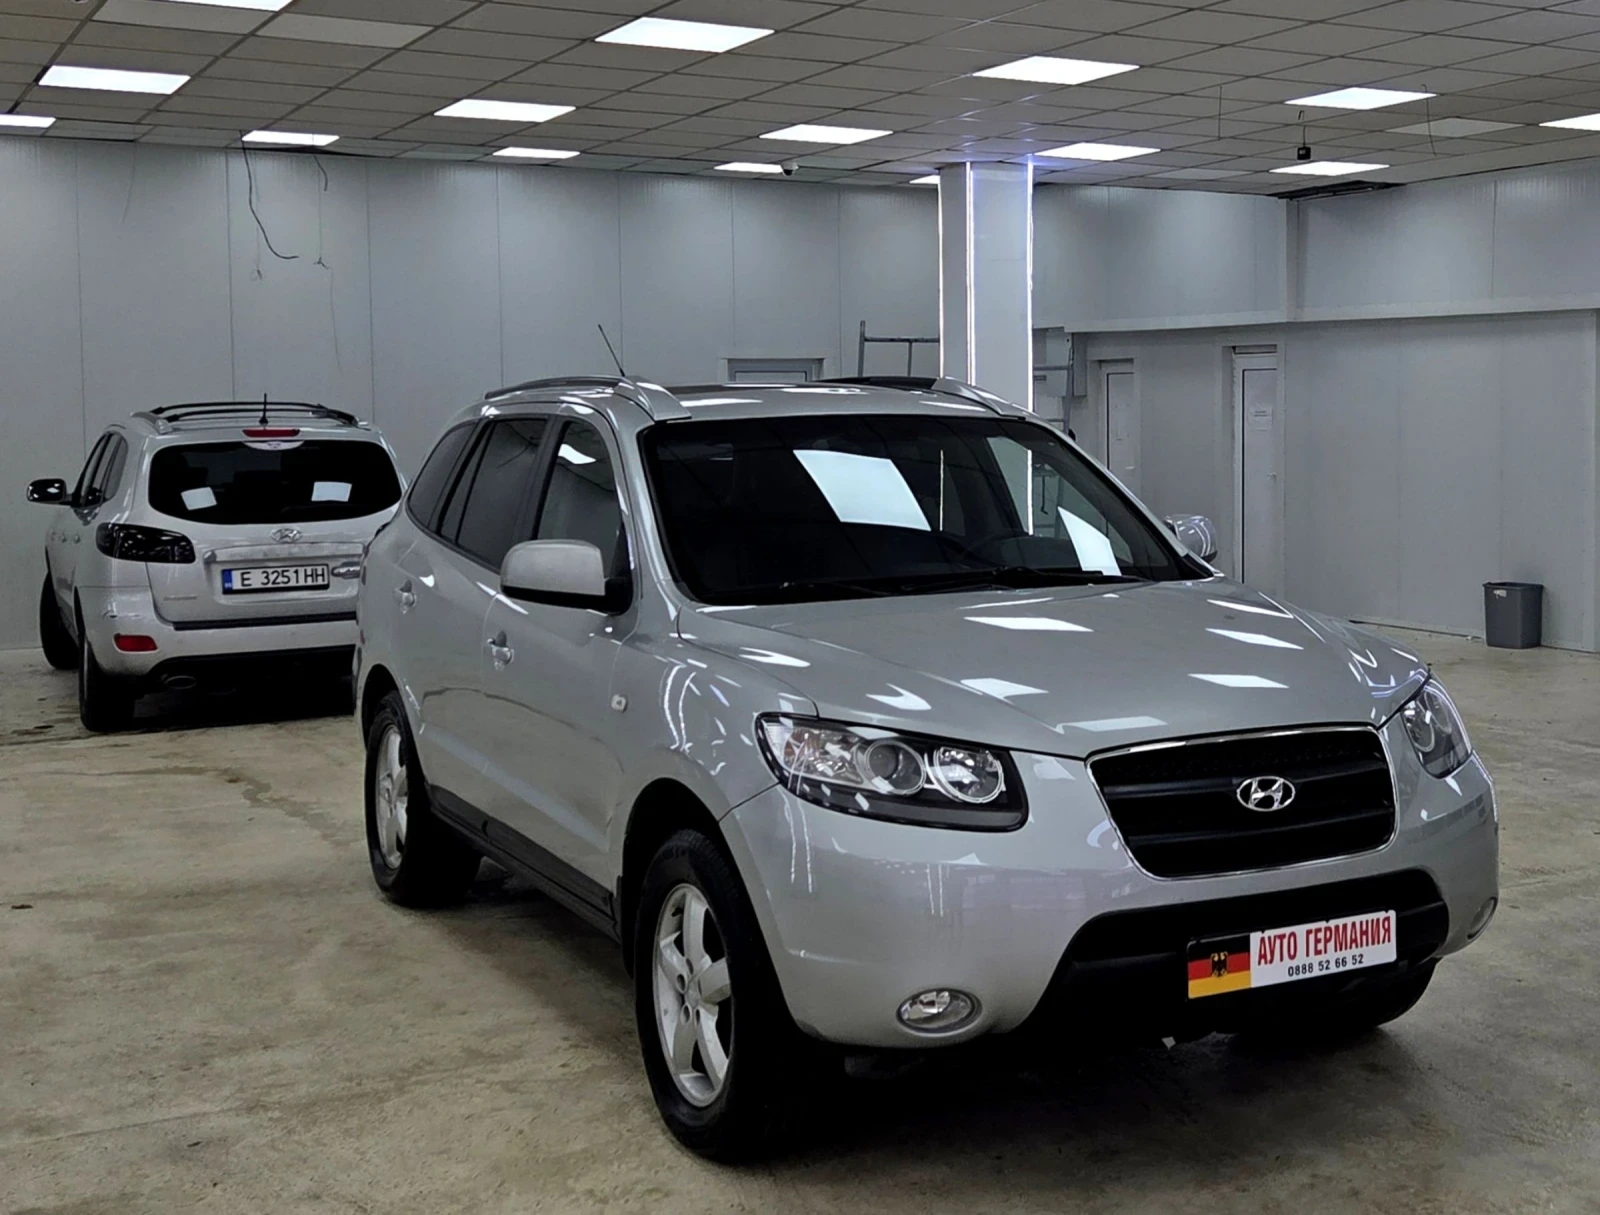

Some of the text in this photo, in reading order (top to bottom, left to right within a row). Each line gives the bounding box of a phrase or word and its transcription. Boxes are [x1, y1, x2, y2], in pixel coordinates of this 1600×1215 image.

[240, 571, 252, 587] E
[1257, 915, 1392, 966] АУТО ГЕРМАНИЯ
[1287, 954, 1364, 977] 0888 52 66 52
